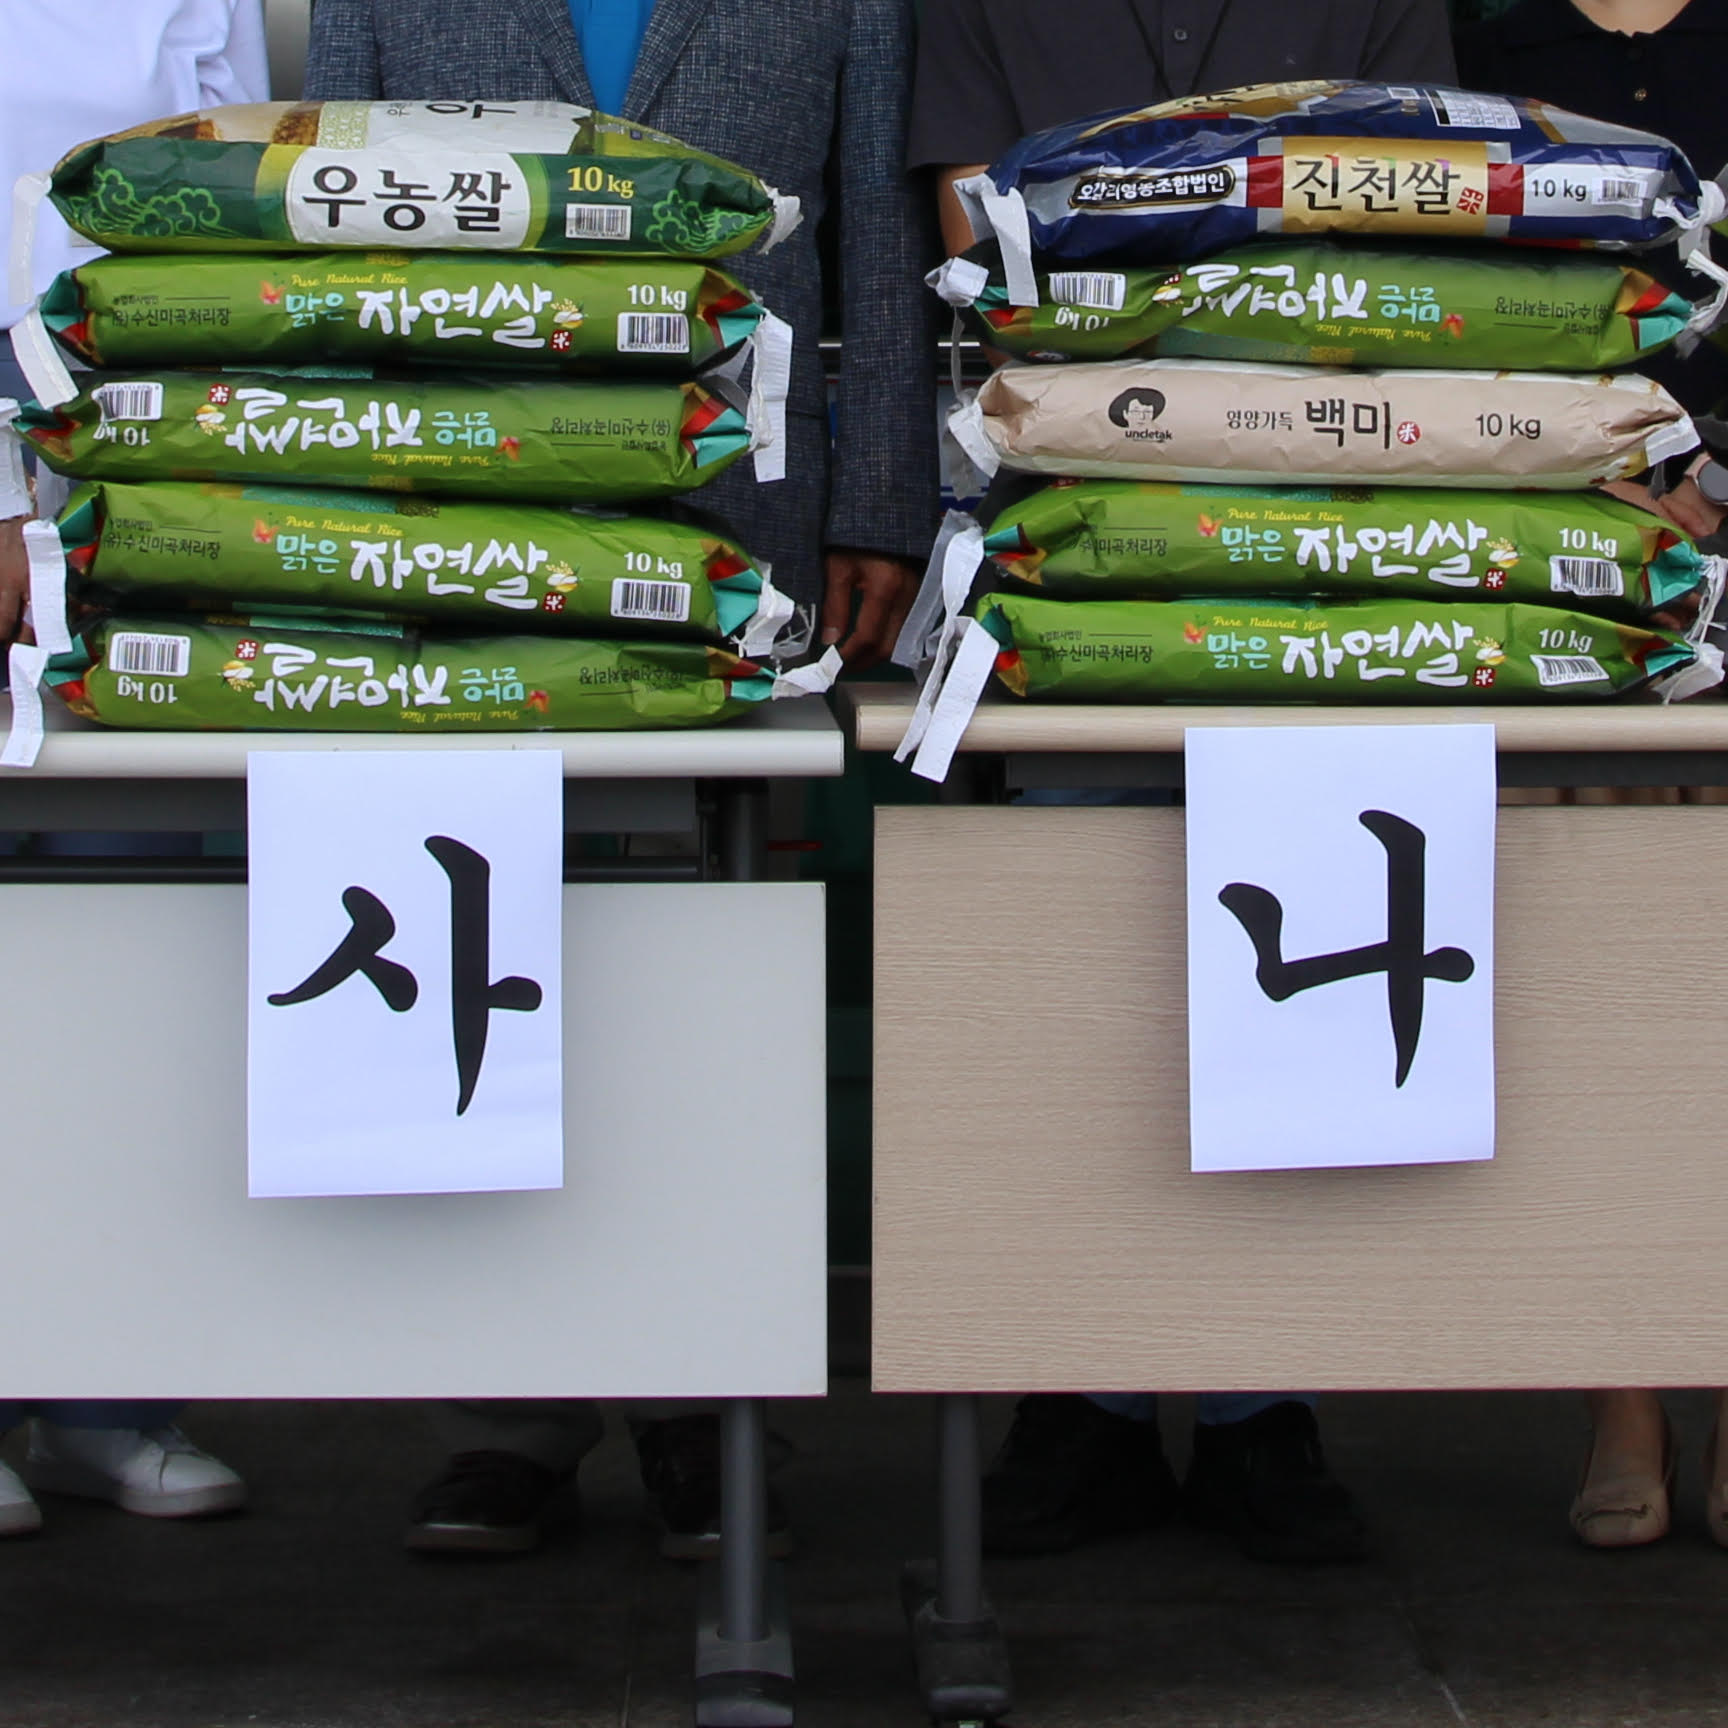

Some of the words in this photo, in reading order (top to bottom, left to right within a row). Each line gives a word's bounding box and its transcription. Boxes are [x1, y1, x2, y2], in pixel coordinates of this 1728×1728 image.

[302, 165, 511, 232] 우농쌀
[567, 166, 602, 192] 10
[607, 174, 634, 199] kg
[1291, 154, 1460, 216] 진천쌀
[1531, 181, 1553, 198] 10
[1560, 181, 1587, 204] kg
[628, 284, 655, 305] 10
[660, 285, 688, 311] kg
[1182, 264, 1368, 320] 자연쌀
[1378, 284, 1440, 323] 맑은
[285, 292, 345, 329] 맑은
[356, 281, 553, 349] 자연쌀
[93, 422, 119, 443] kg
[124, 427, 151, 447] 10
[224, 387, 423, 456] 자연쌀
[432, 410, 498, 450] 맑은
[1227, 410, 1294, 431] 영양가득
[1305, 399, 1391, 449] 백미
[1476, 414, 1502, 436] 10
[1510, 413, 1541, 440] kg
[285, 516, 315, 529] Pure
[321, 519, 371, 534] Natural
[377, 524, 404, 537] Rice
[1559, 528, 1587, 549] 10
[1592, 531, 1617, 558] kg
[276, 534, 340, 574] 맑은
[350, 538, 548, 611] 자연쌀
[624, 552, 652, 572] 10
[657, 556, 683, 578] kg
[1221, 526, 1286, 563] 맑은
[1293, 518, 1488, 588] 자연쌀
[1207, 632, 1272, 670] 맑은
[1279, 620, 1474, 688] 자연쌀
[1538, 628, 1564, 648] 10
[1567, 629, 1594, 654] kg
[117, 677, 145, 702] kg
[150, 683, 177, 704] 10
[254, 642, 451, 712] 자연쌀
[458, 665, 524, 705] 맑은
[1217, 808, 1476, 1089] 나
[267, 835, 543, 1117] 사
